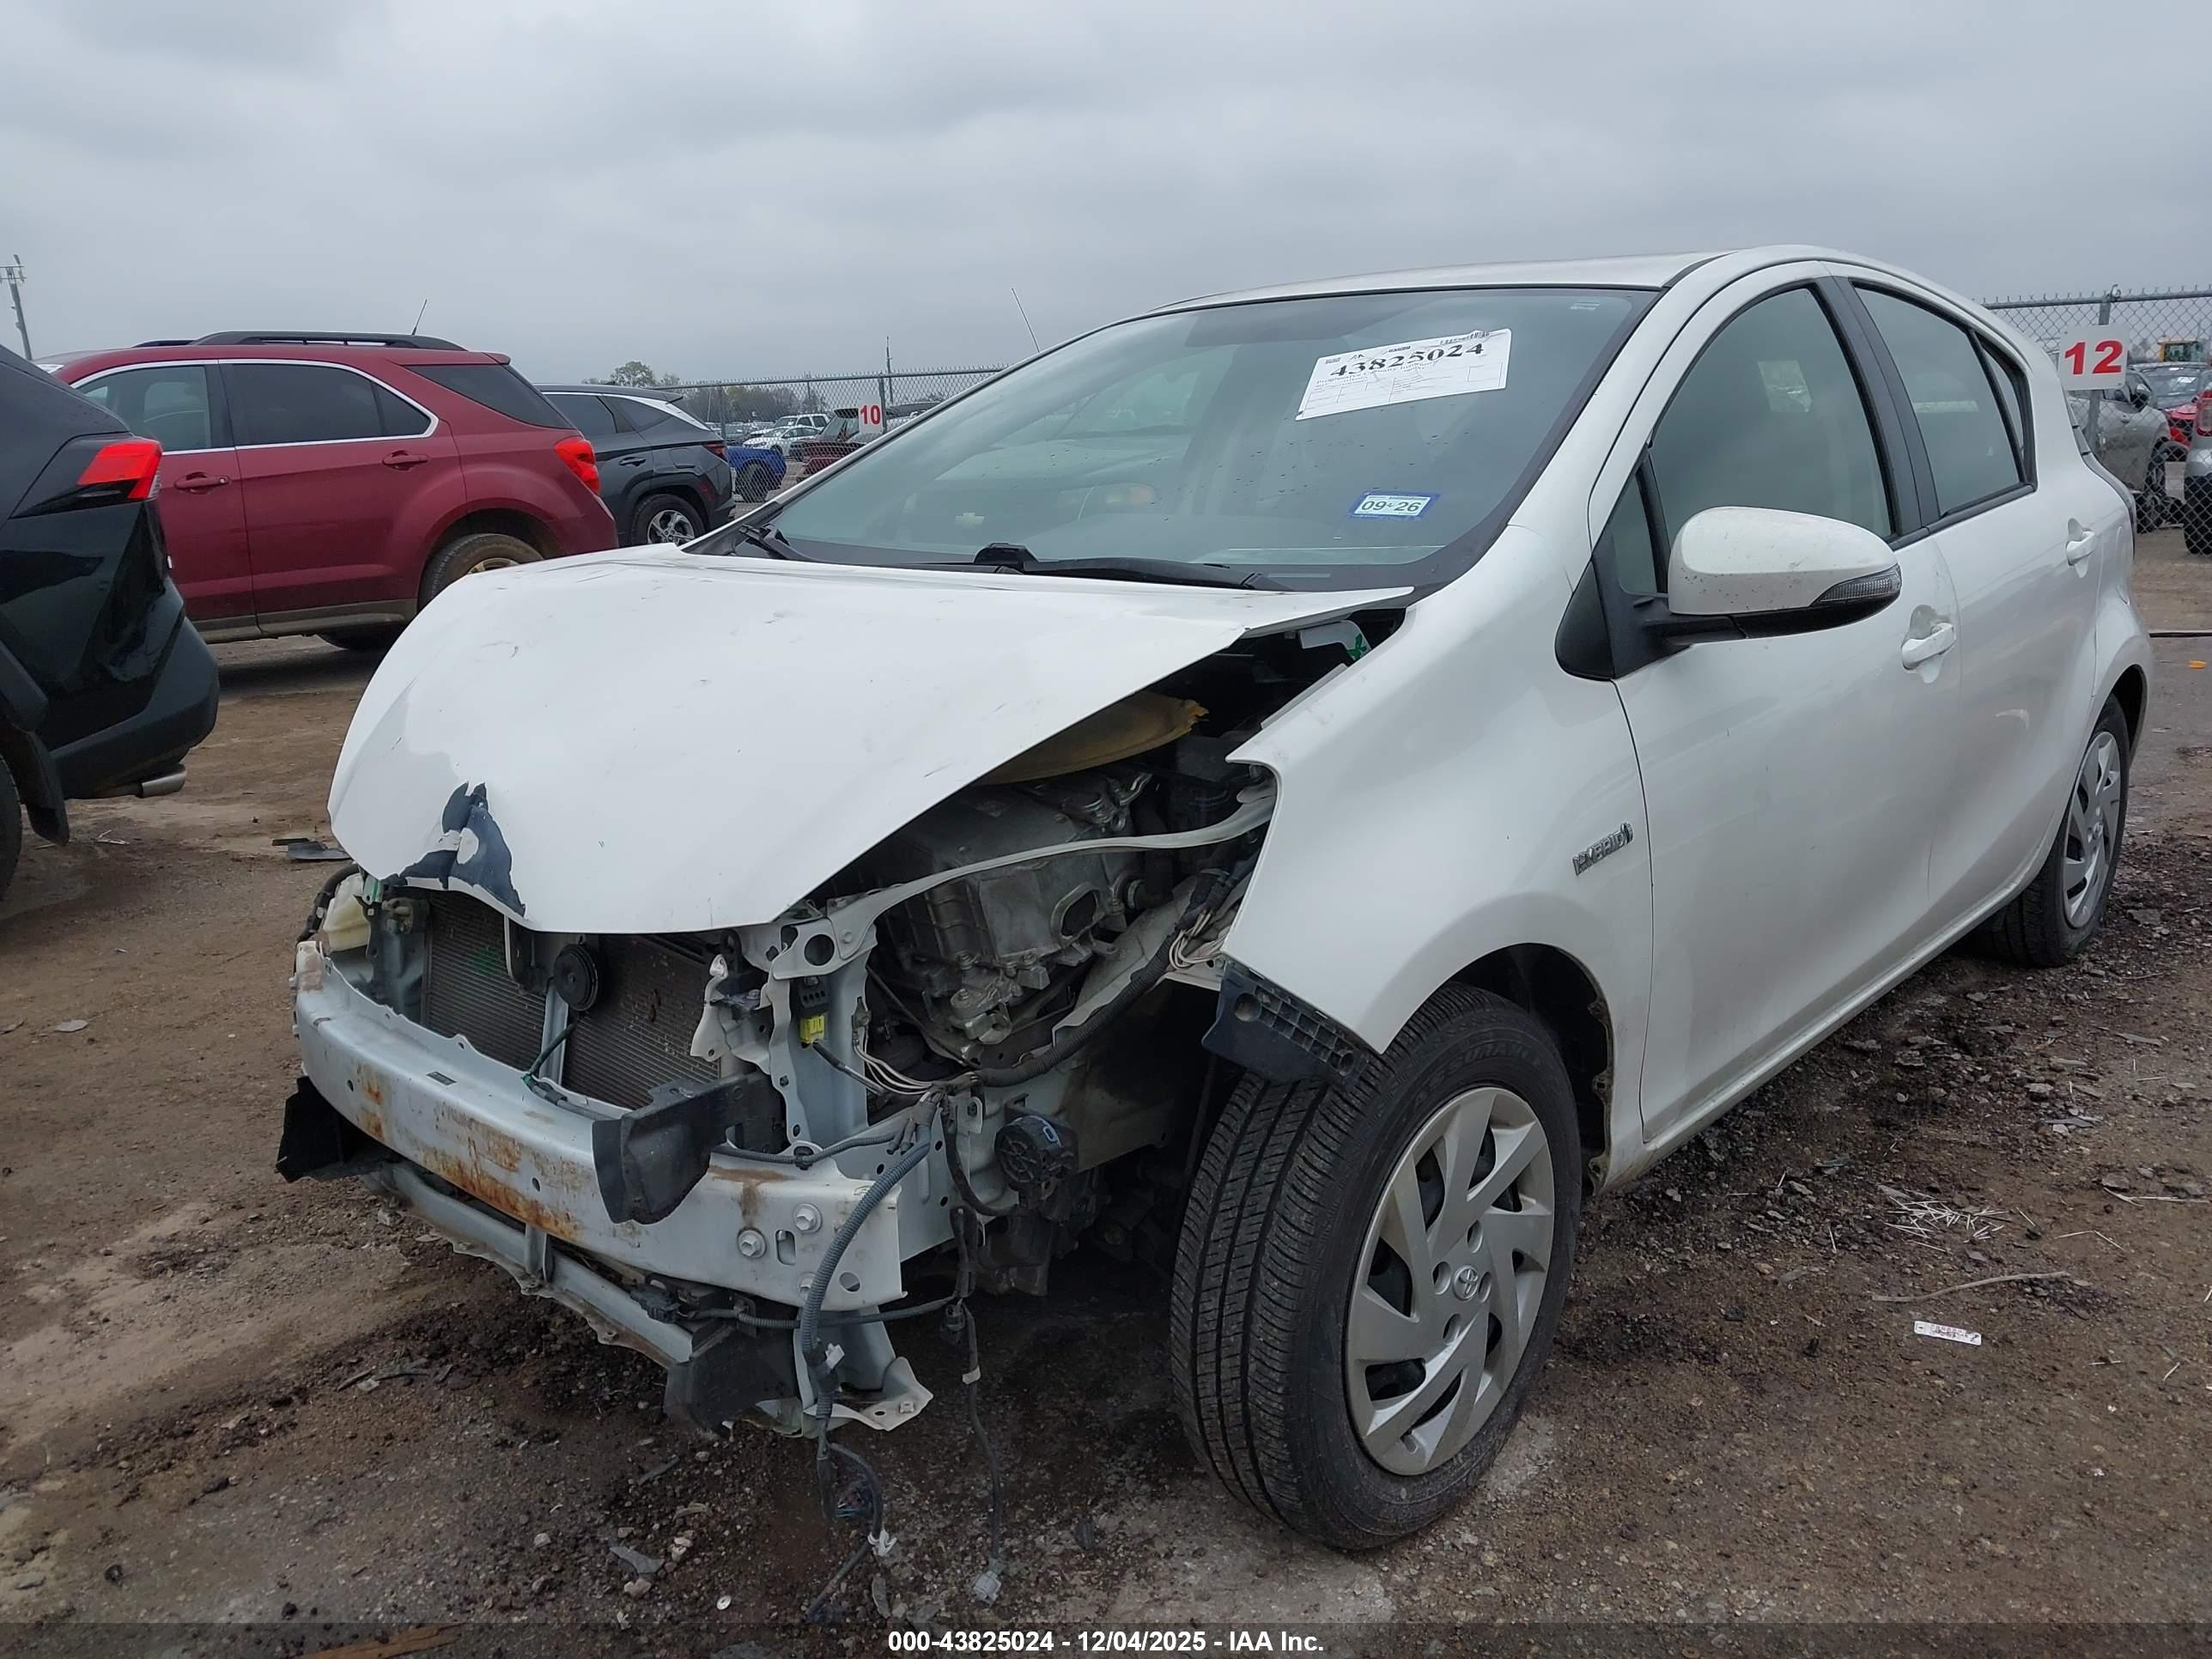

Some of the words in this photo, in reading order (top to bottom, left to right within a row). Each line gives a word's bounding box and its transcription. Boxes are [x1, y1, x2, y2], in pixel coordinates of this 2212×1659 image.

[1330, 343, 1485, 377] 43825024
[2063, 339, 2124, 375] 12
[860, 404, 881, 425] 10
